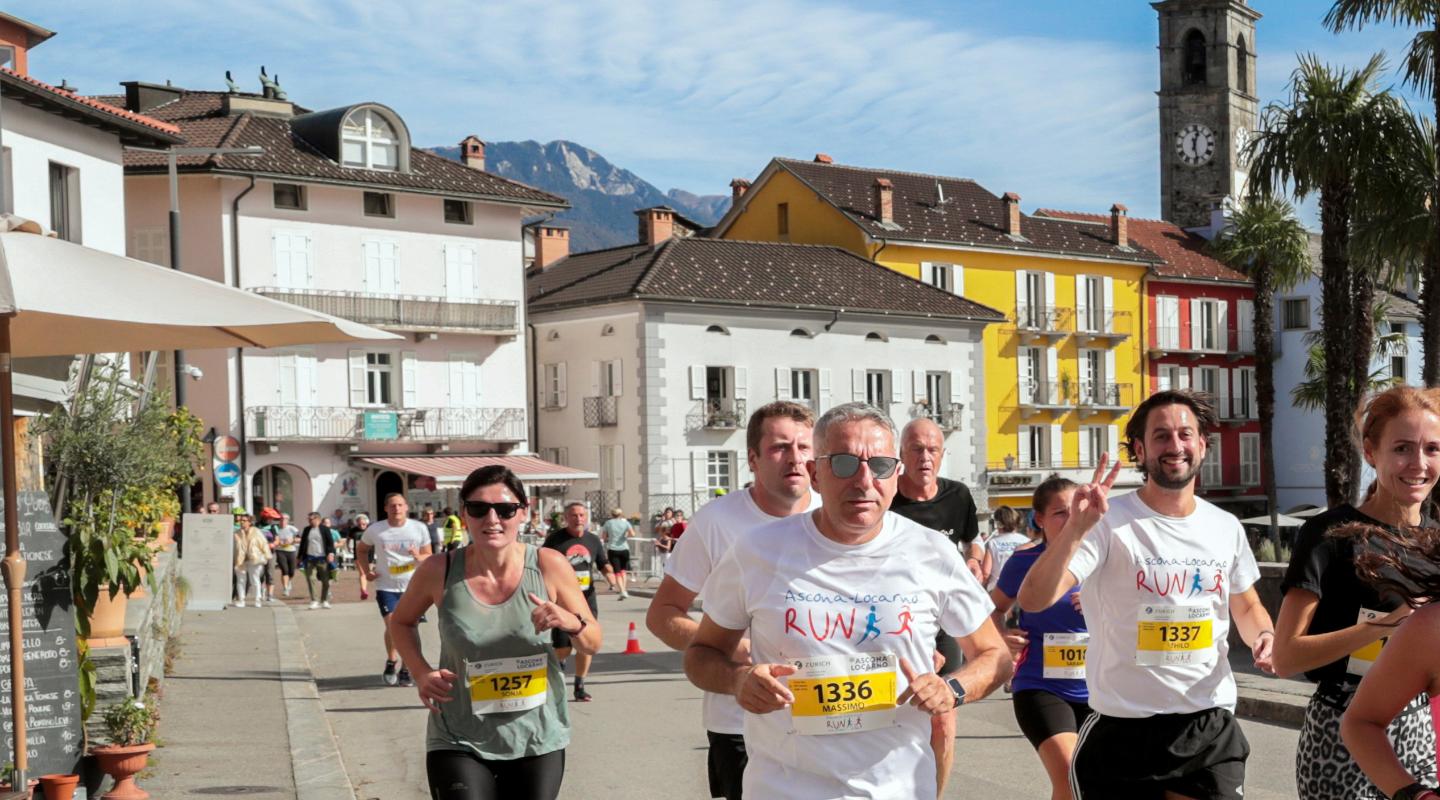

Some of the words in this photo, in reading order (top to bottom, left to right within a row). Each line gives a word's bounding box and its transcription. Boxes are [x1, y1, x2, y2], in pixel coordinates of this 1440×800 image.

[1136, 569, 1187, 597] RUN
[785, 589, 919, 604] Ascona-Locarno
[784, 607, 856, 642] RUN
[1159, 625, 1201, 642] 1337
[804, 660, 831, 668] ZURICH
[490, 674, 533, 692] 1257
[813, 679, 873, 704] 1336
[822, 702, 865, 713] MASSIMO
